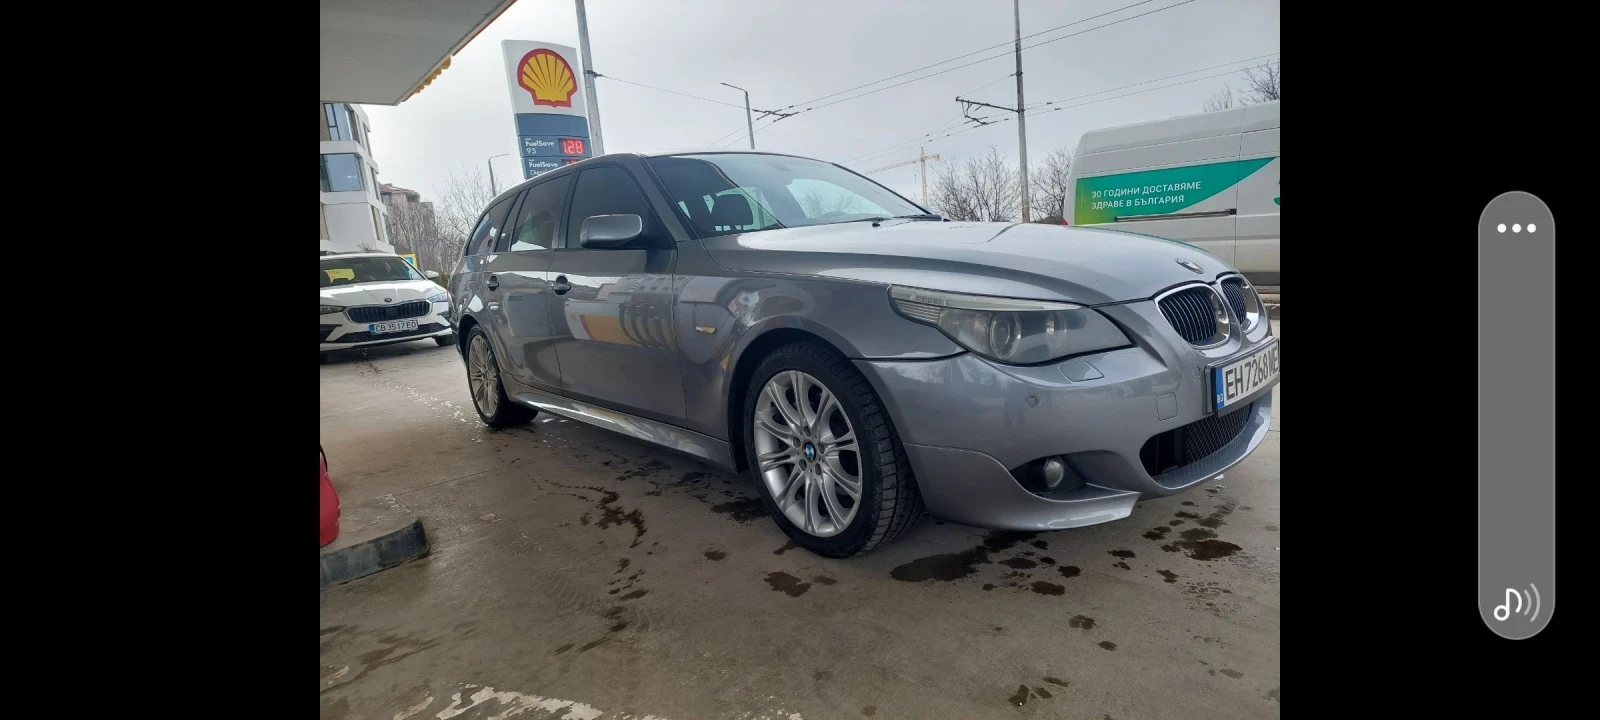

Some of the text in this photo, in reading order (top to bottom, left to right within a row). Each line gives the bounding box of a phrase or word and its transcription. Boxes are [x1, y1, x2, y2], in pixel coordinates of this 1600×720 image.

[1091, 181, 1202, 198] 30 ГОДИНИ ДОСТАВЯМЕ
[1091, 199, 1124, 210] ЗДРАВЕ
[1134, 195, 1184, 206] БЪЛГАРИЯ
